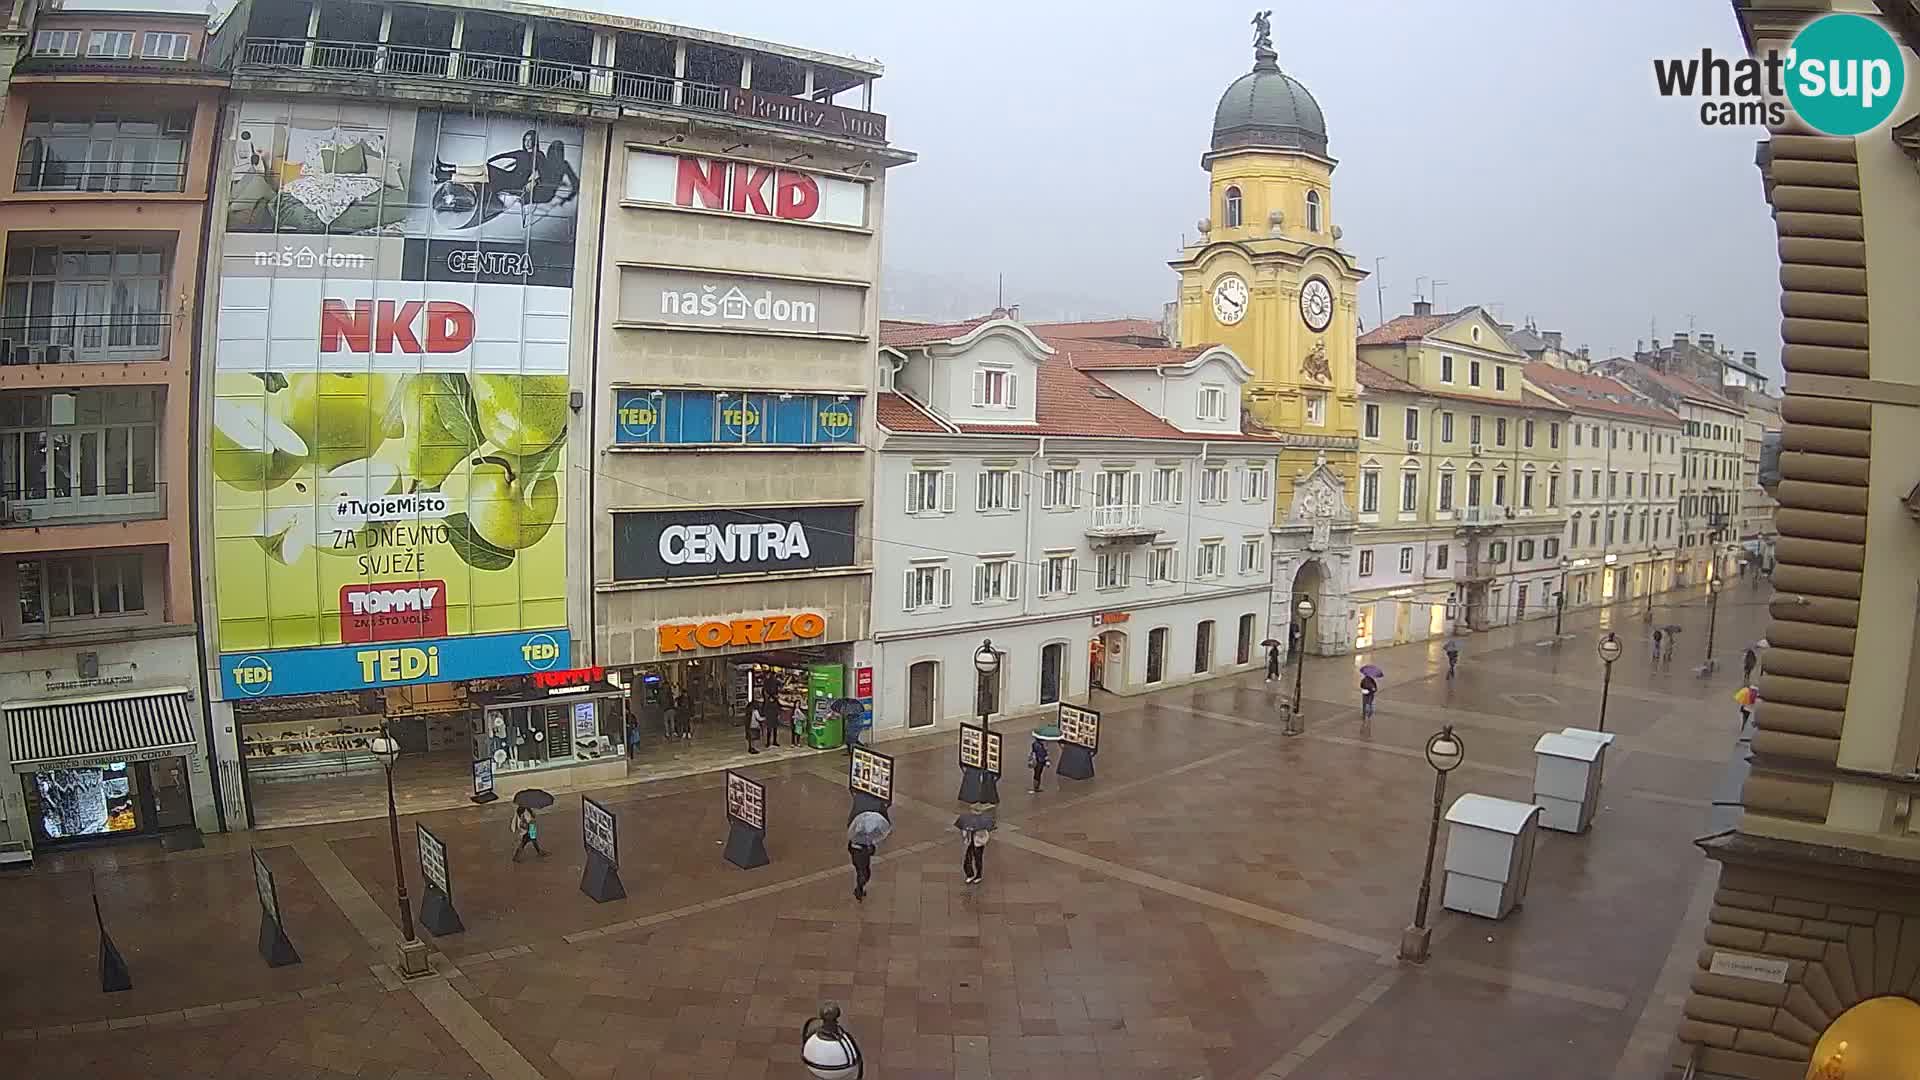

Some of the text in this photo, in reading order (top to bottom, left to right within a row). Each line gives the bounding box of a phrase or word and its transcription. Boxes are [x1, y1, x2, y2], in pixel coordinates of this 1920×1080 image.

[675, 157, 820, 220] NKD
[255, 246, 365, 268] naš dom
[448, 250, 535, 276] CENTRA
[661, 284, 816, 323] naš dom
[320, 299, 476, 353] NKD
[618, 408, 657, 426] TEDi
[723, 409, 760, 426] TEDi
[819, 411, 853, 428] TEDi
[337, 498, 445, 517] #TvojeMisto
[333, 525, 449, 550] ZA DNEVNO
[658, 521, 810, 565] CENTRA
[358, 549, 426, 576] SVJEŽE
[348, 587, 439, 615] TOMMY
[658, 612, 825, 653] KORZO
[521, 642, 559, 661] TEDi
[233, 666, 273, 685] TEDi
[357, 646, 439, 683] TEDi
[534, 666, 604, 688] TOMMY
